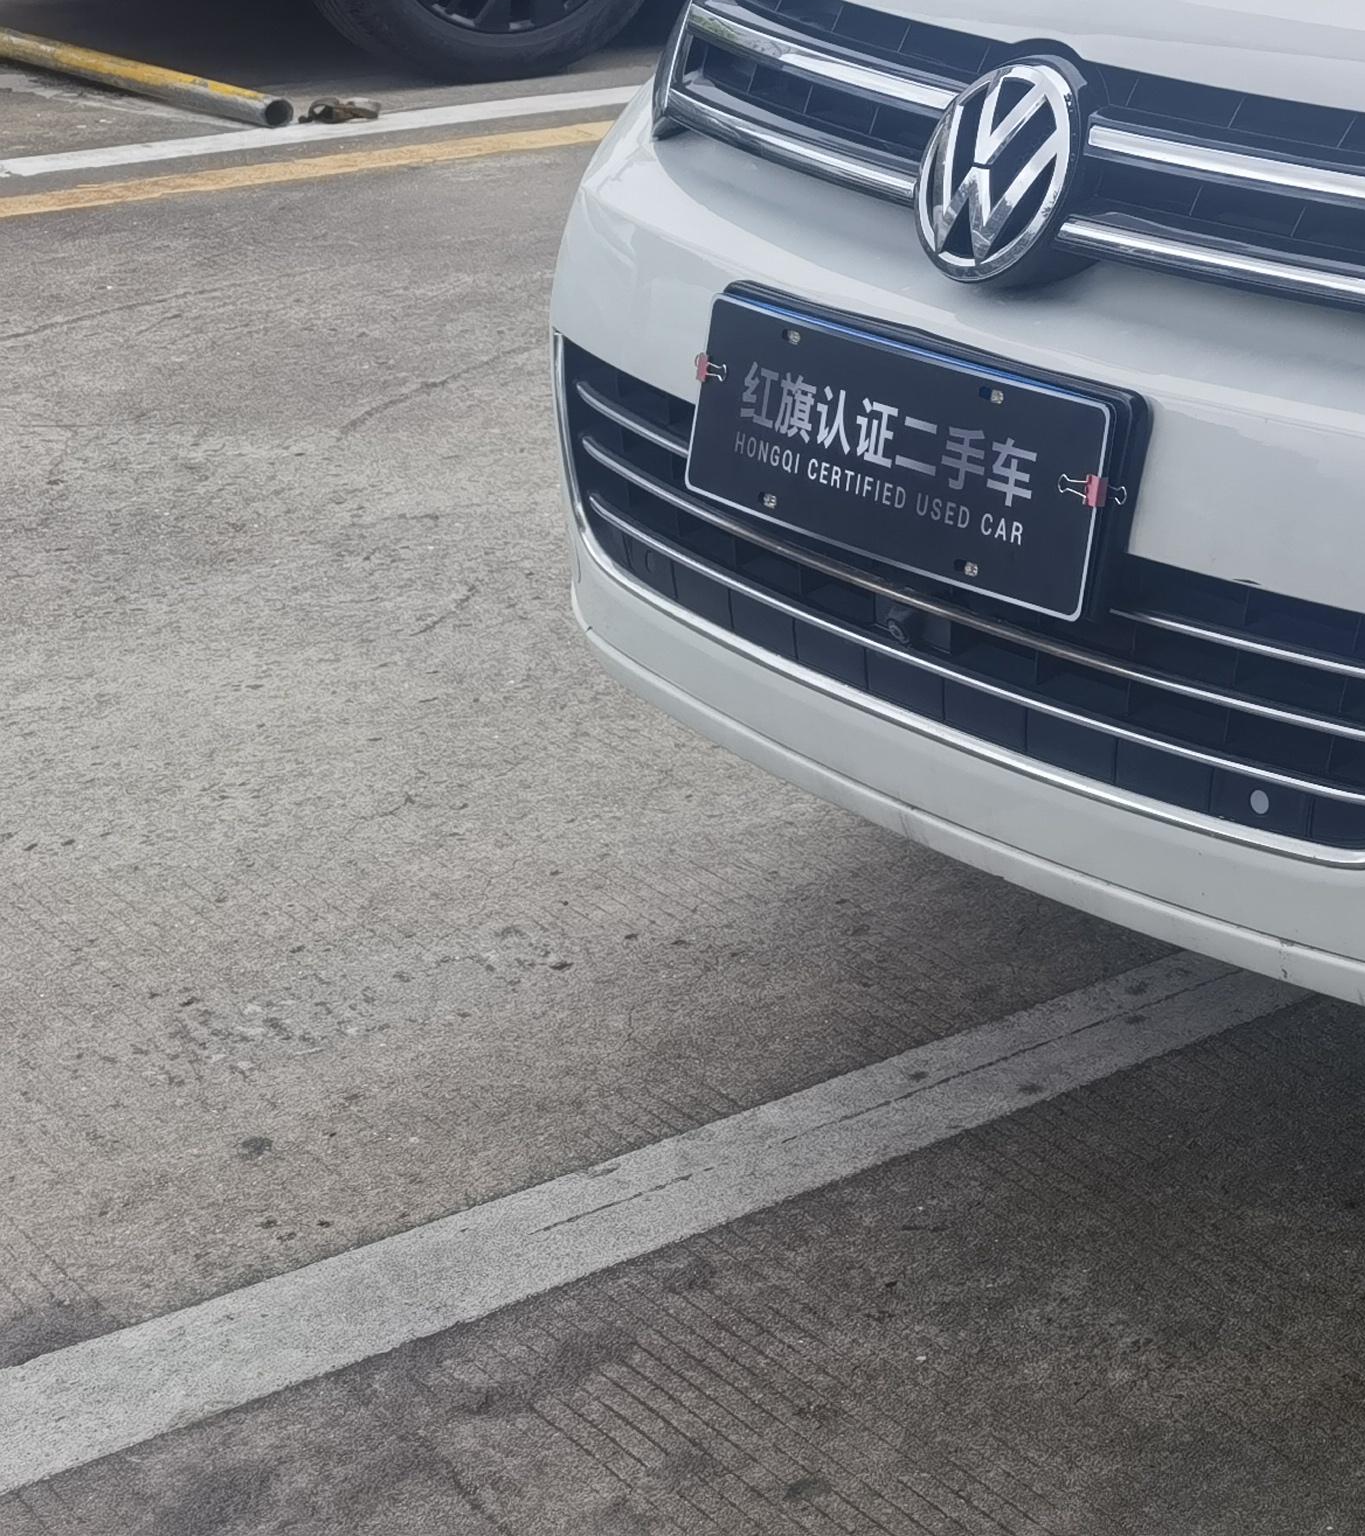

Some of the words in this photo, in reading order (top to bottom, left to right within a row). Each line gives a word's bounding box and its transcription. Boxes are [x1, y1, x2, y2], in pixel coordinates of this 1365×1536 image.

[734, 431, 799, 475] HONGQI
[807, 458, 907, 509] CERTIFIED
[916, 493, 971, 529] USED
[980, 513, 1023, 546] CAR
[738, 362, 1038, 507] 红旗认证二手车
